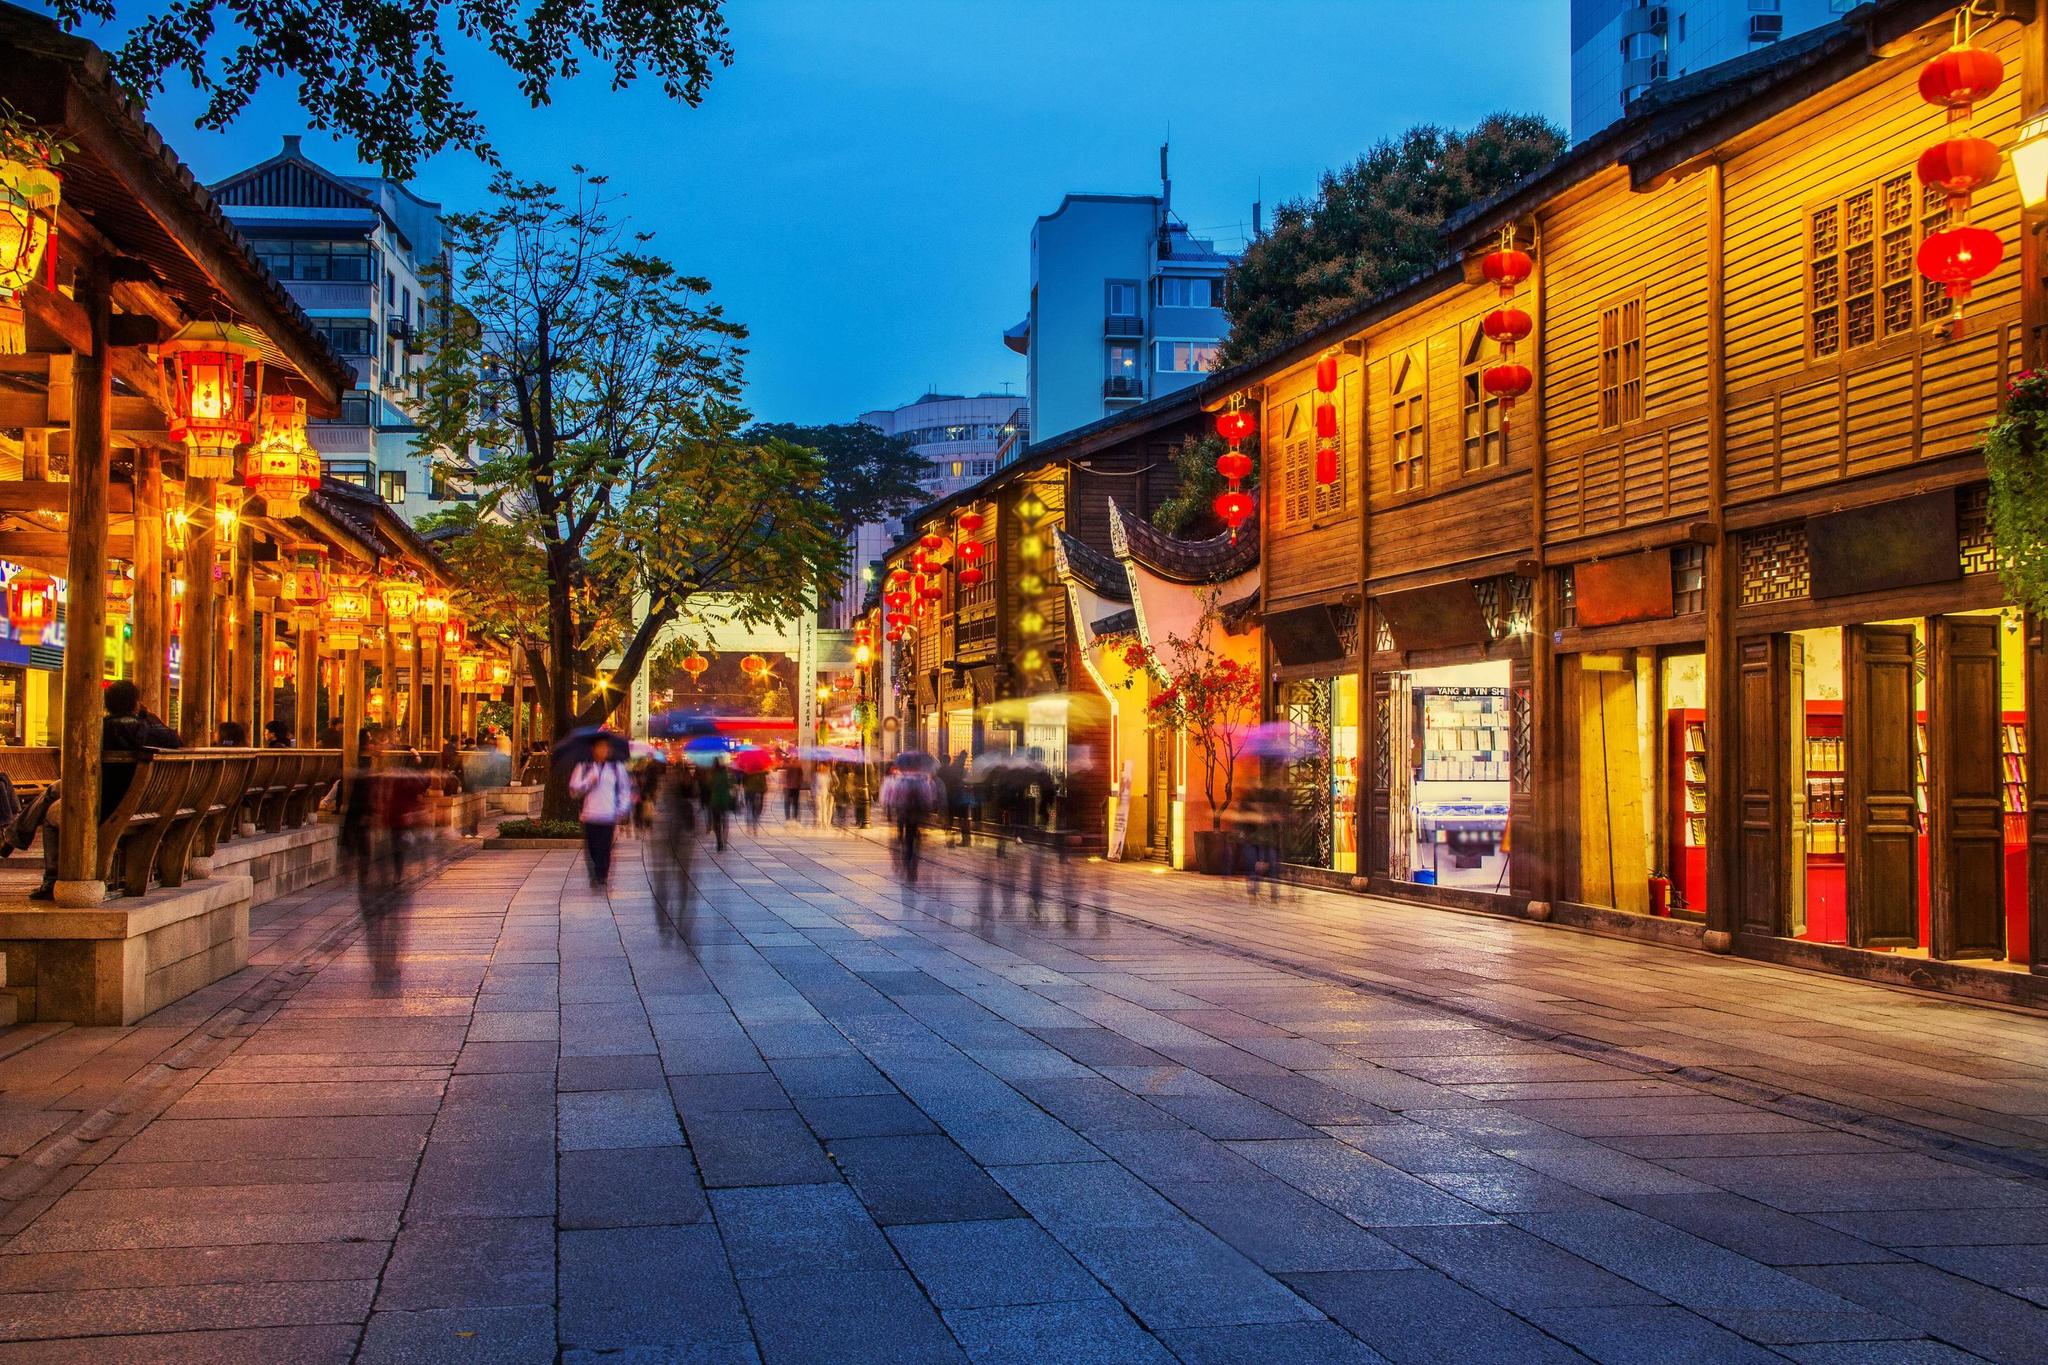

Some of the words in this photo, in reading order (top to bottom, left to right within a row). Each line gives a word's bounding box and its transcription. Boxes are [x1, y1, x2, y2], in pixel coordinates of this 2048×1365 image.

[1437, 687, 1459, 695] YANG
[1463, 687, 1470, 695] JI
[1474, 687, 1488, 695] YIN
